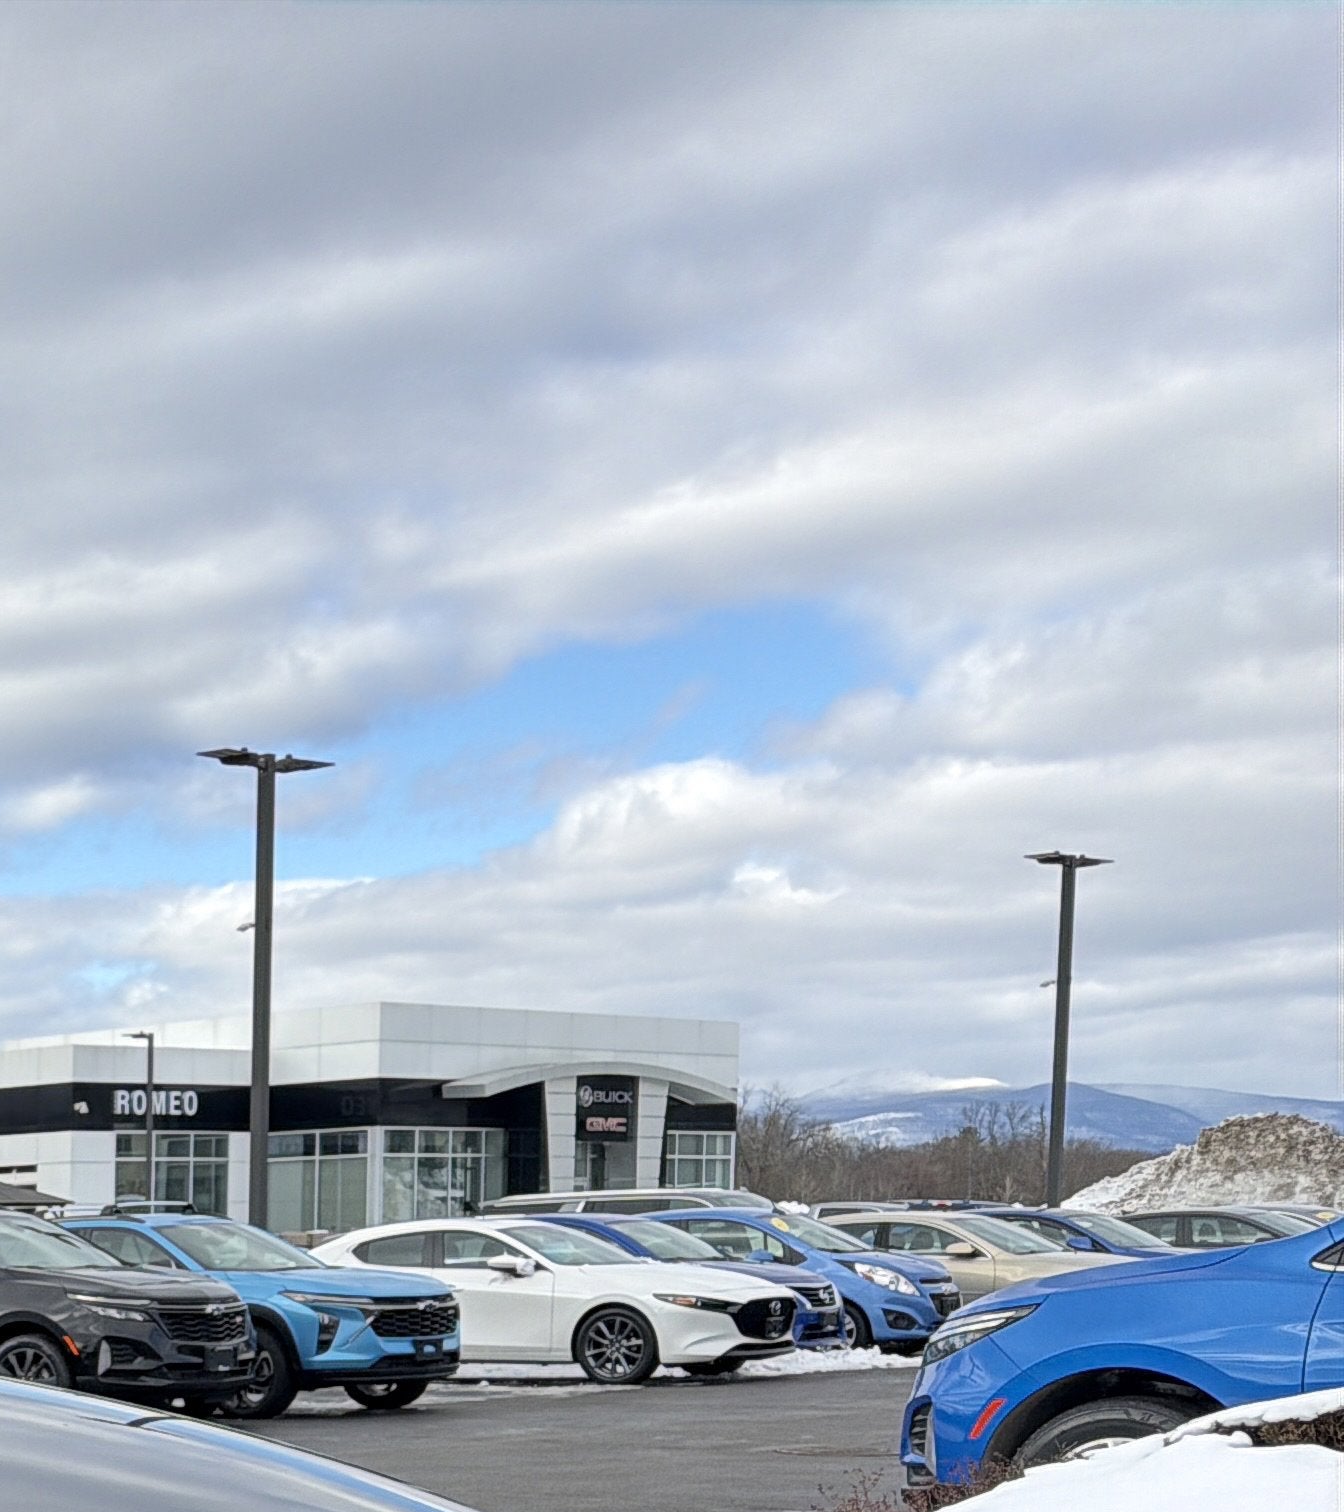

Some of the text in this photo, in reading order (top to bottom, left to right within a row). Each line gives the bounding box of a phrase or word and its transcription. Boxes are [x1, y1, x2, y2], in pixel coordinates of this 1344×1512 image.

[113, 1089, 198, 1116] ROMEO
[593, 1090, 633, 1104] BUICK
[585, 1116, 627, 1133] GMC
